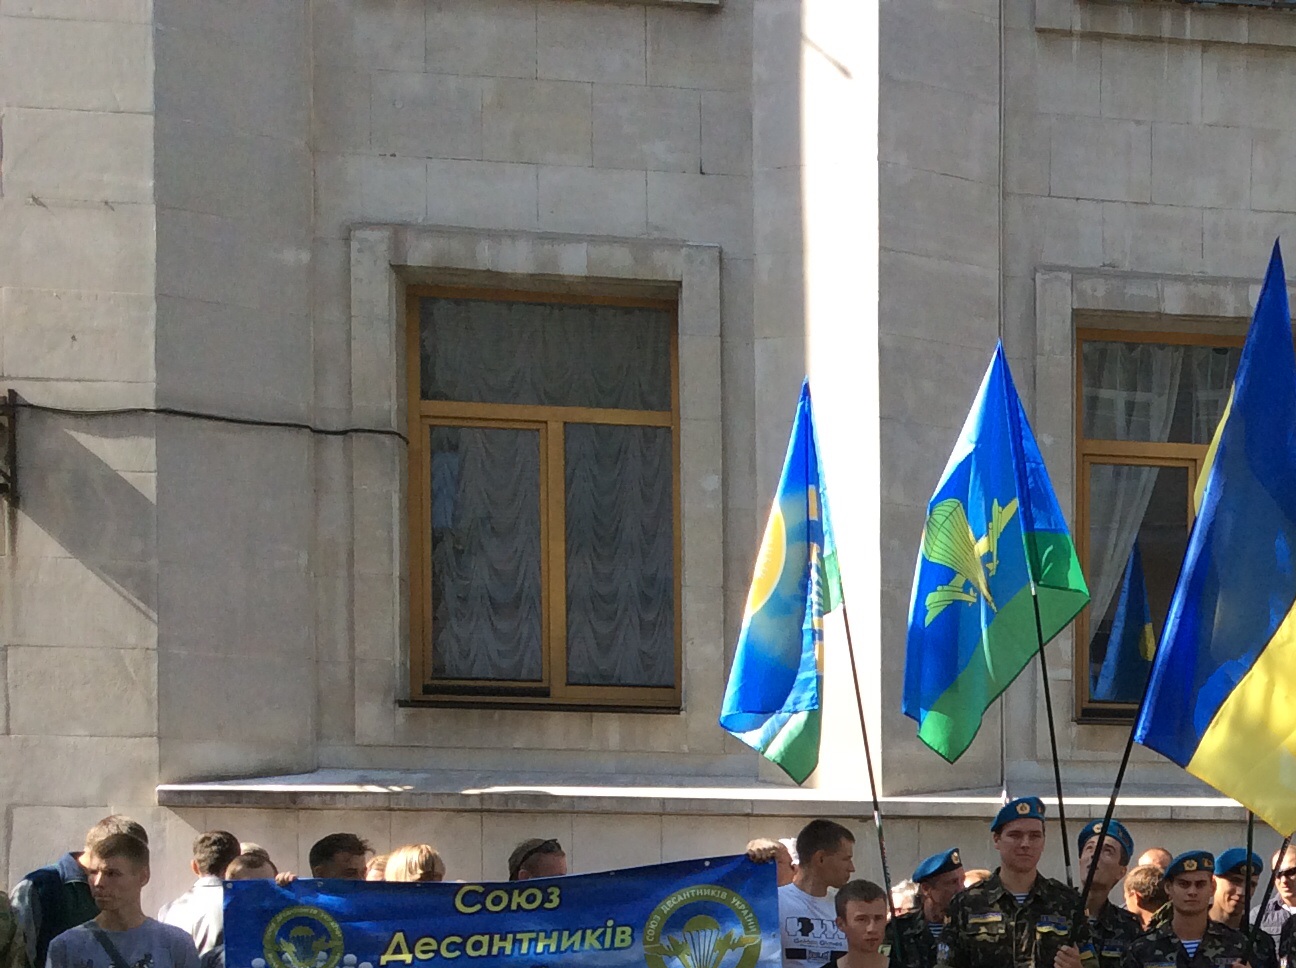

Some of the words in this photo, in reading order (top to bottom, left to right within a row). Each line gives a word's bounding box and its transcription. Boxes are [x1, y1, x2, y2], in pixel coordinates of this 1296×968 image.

[454, 885, 561, 914] Союз
[645, 914, 661, 942] СОЮЗ
[660, 888, 728, 914] ДЕСАНТНИКІВ
[379, 919, 633, 966] Десантників
